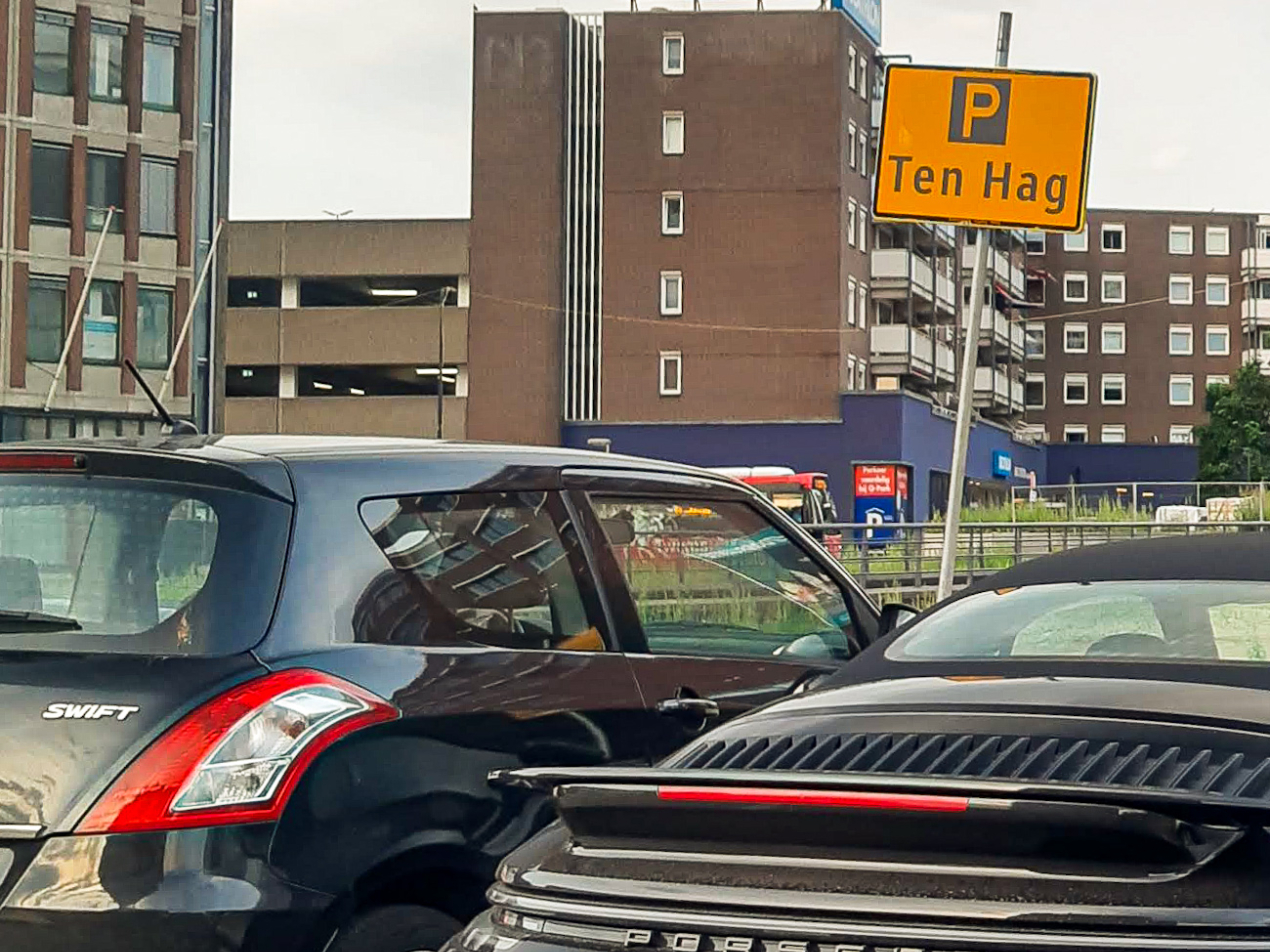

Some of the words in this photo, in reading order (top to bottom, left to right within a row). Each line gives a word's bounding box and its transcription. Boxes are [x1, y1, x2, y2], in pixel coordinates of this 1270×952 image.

[962, 82, 1001, 138] P
[888, 155, 963, 197] Ten
[983, 161, 1068, 214] Hag
[42, 703, 139, 721] SWIFT
